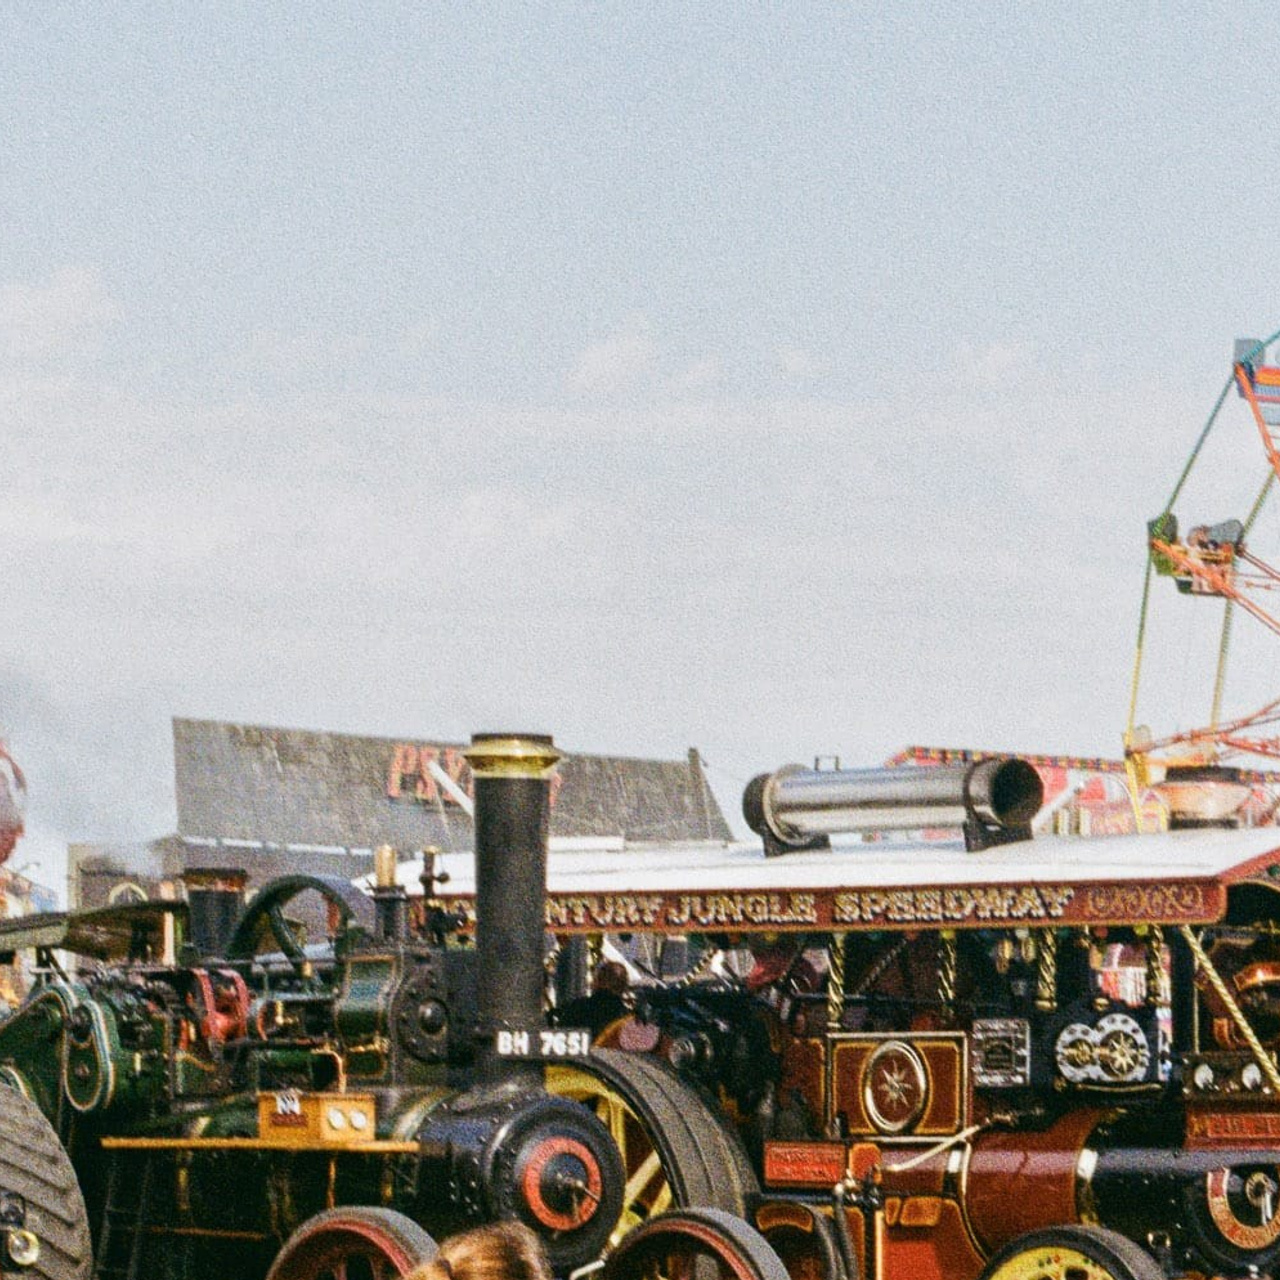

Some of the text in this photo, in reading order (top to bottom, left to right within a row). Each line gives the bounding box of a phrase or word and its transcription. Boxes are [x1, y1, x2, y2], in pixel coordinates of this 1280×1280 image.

[544, 887, 1076, 925] NTURY JUNGLE SPEEDWAY
[497, 1031, 589, 1057] BH 7651
